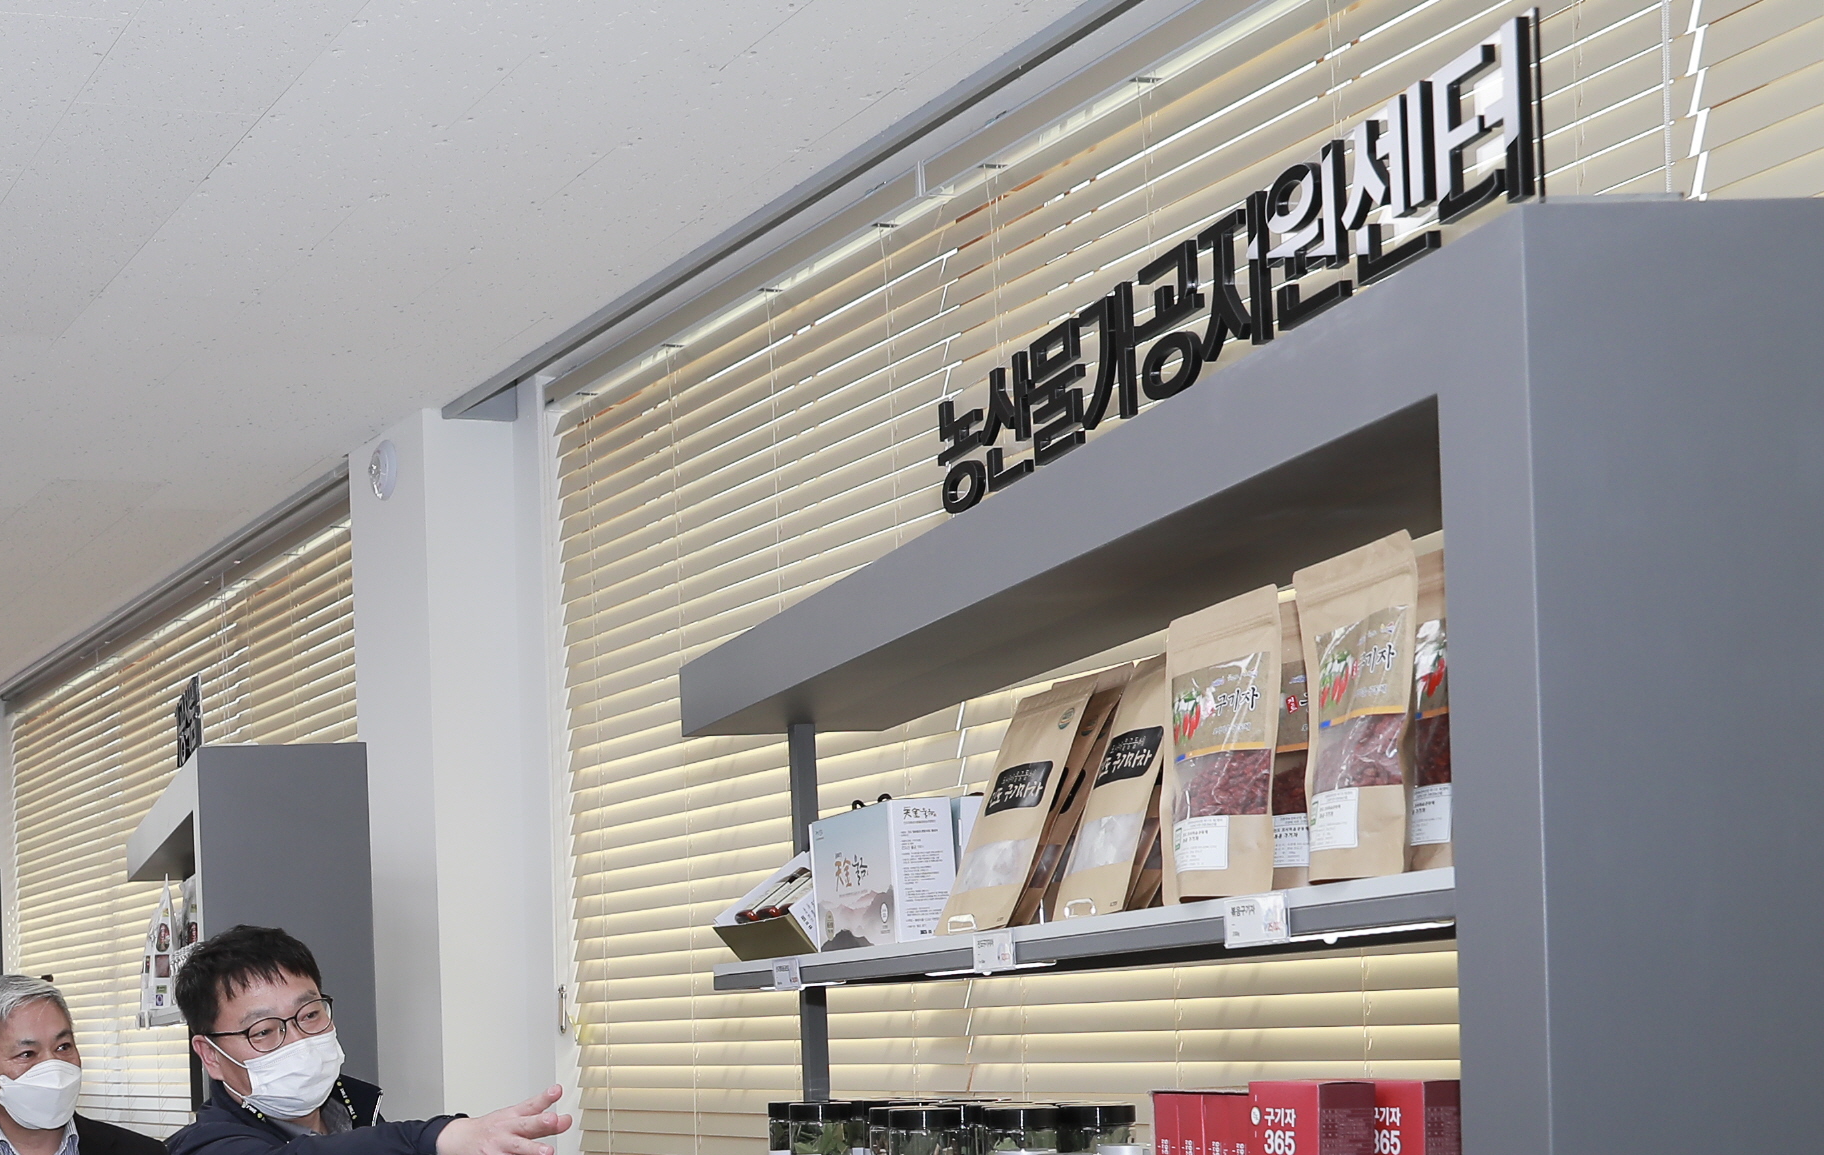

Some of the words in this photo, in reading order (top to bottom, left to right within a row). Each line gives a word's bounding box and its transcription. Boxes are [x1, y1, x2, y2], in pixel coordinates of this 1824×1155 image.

[937, 8, 1540, 514] 농산물가공지원센터
[1214, 686, 1260, 717] 구기자
[1231, 904, 1255, 917] 볶음구기자
[1264, 1107, 1296, 1127] 구기자
[1263, 1129, 1296, 1155] 365
